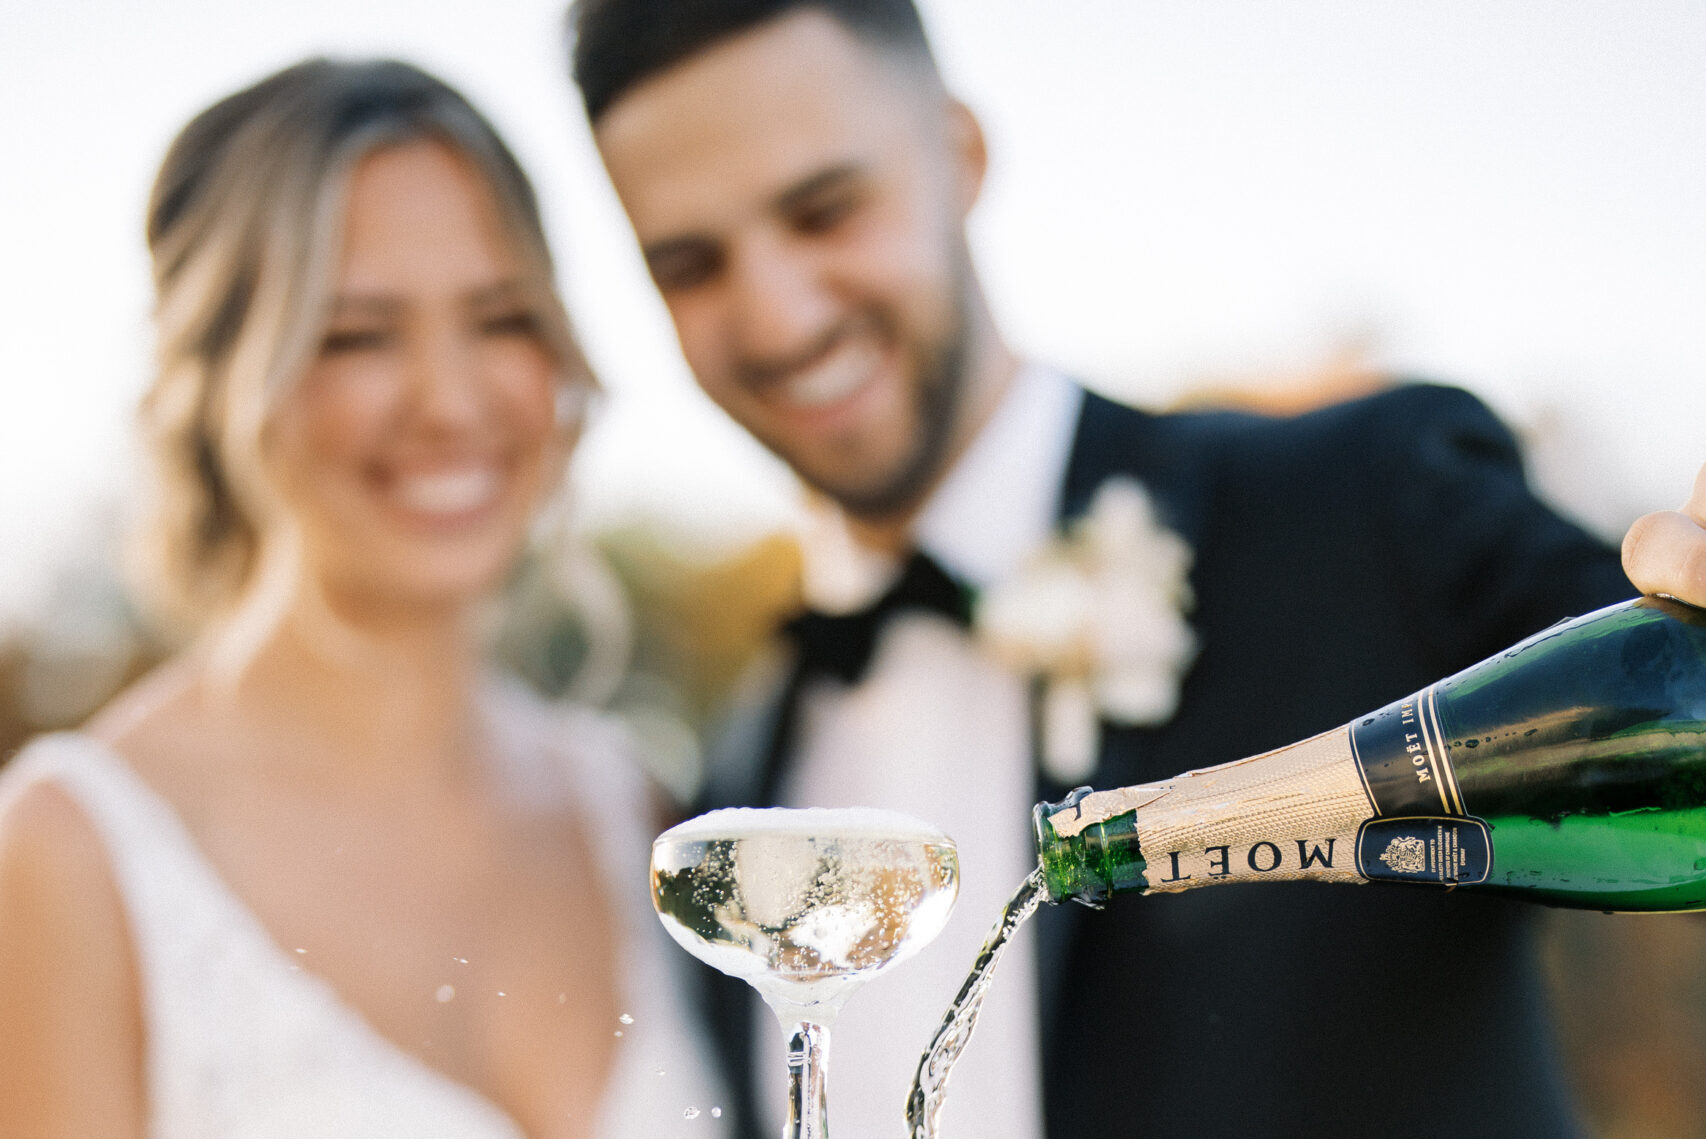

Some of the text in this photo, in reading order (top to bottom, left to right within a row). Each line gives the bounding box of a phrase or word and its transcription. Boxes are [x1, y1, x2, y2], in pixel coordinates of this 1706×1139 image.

[1401, 702, 1431, 784] MOËT IMP
[1160, 838, 1337, 883] MOËT
